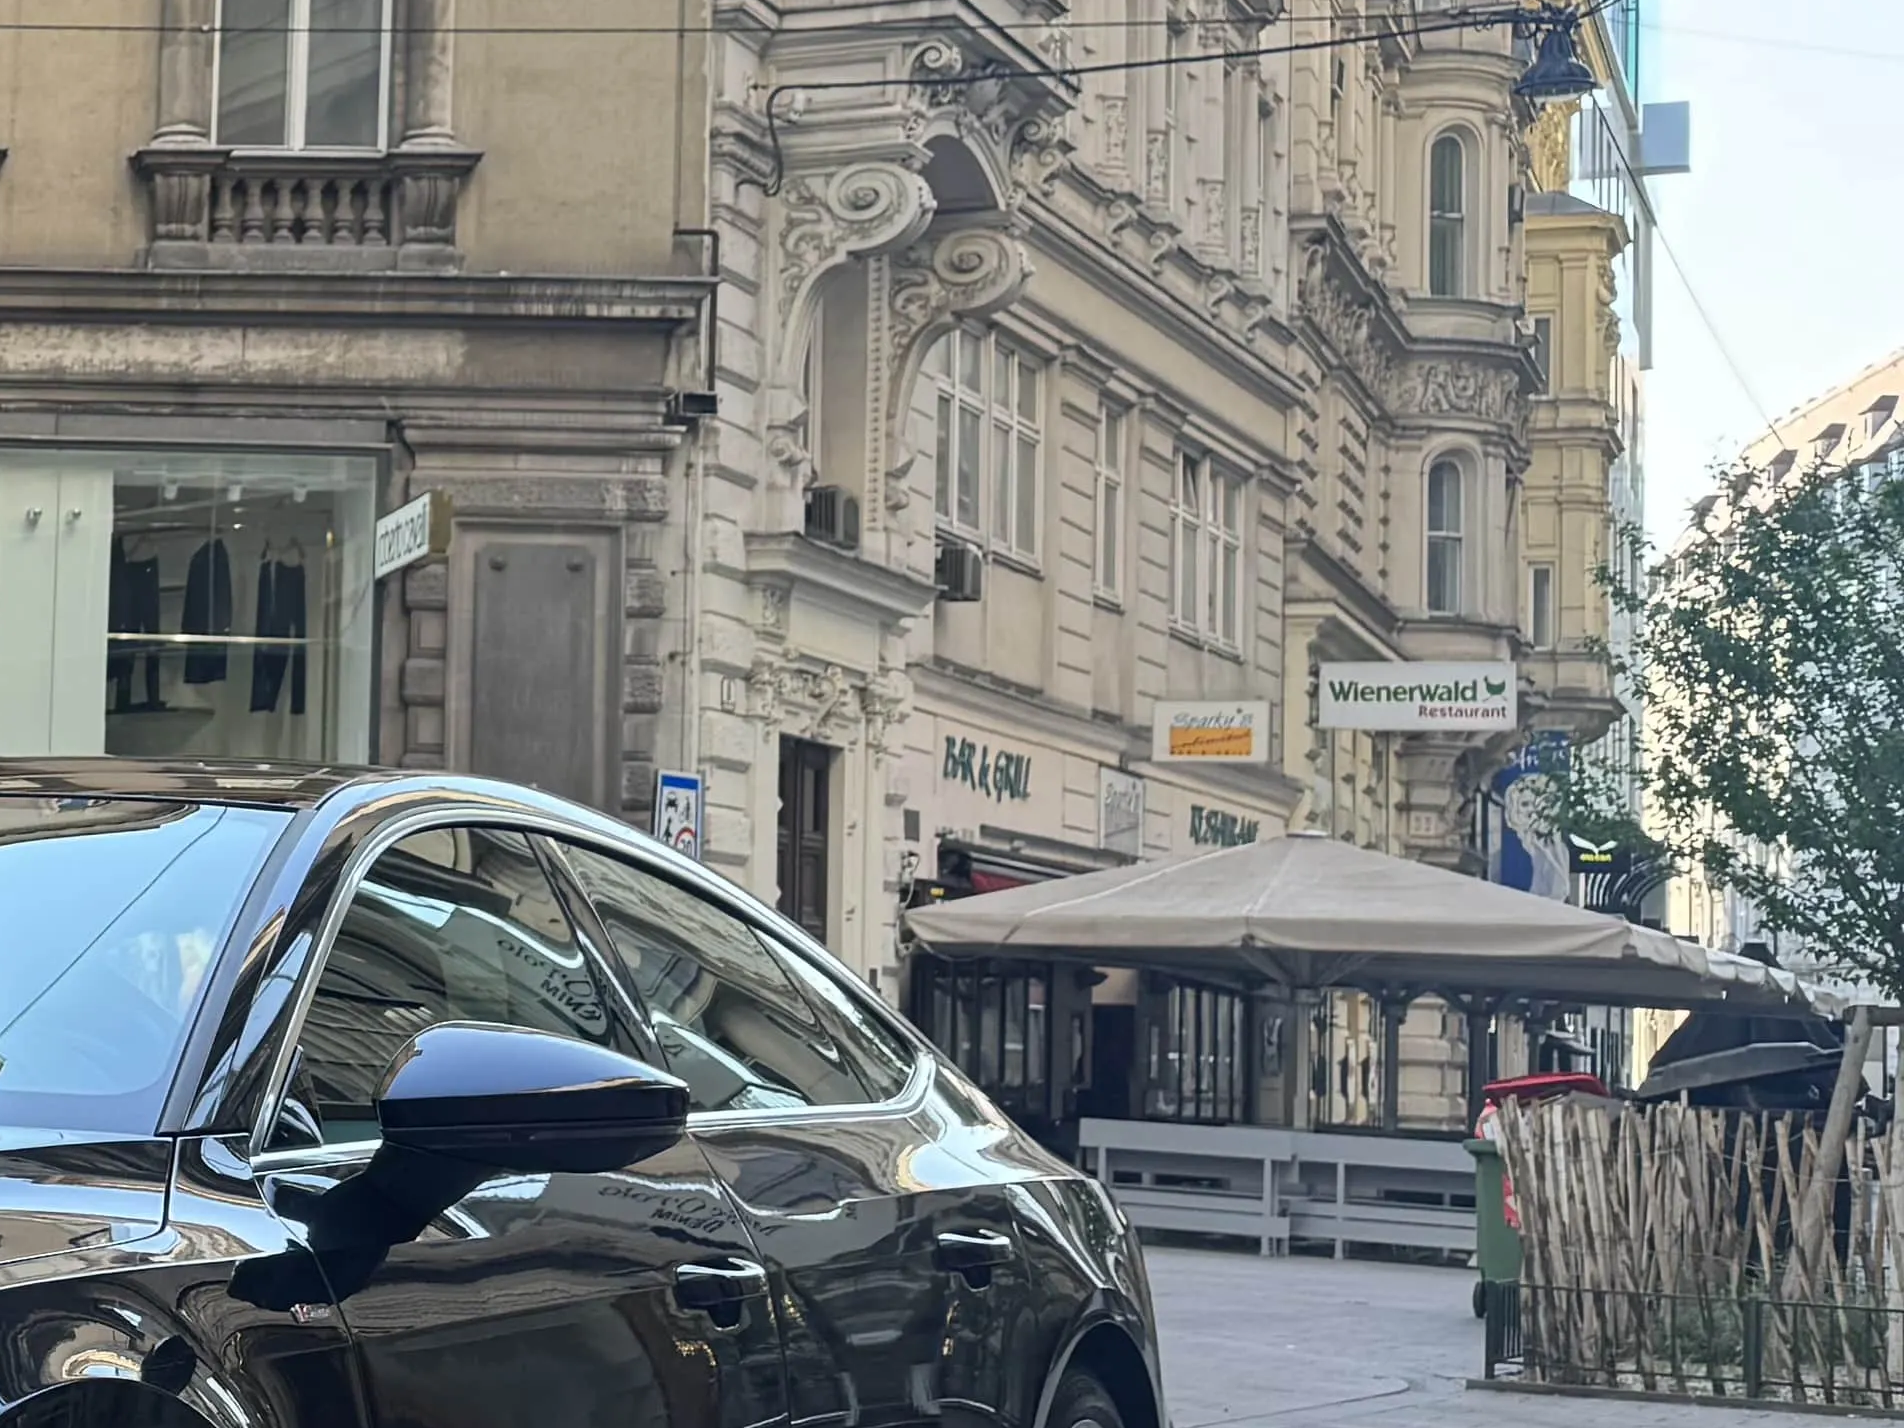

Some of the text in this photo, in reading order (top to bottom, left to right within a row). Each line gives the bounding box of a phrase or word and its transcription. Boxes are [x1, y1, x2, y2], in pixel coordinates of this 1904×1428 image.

[1329, 680, 1478, 703] Wienerwald
[1418, 705, 1507, 719] Restaurant
[944, 735, 976, 791] BAR
[993, 750, 1031, 803] GRILL
